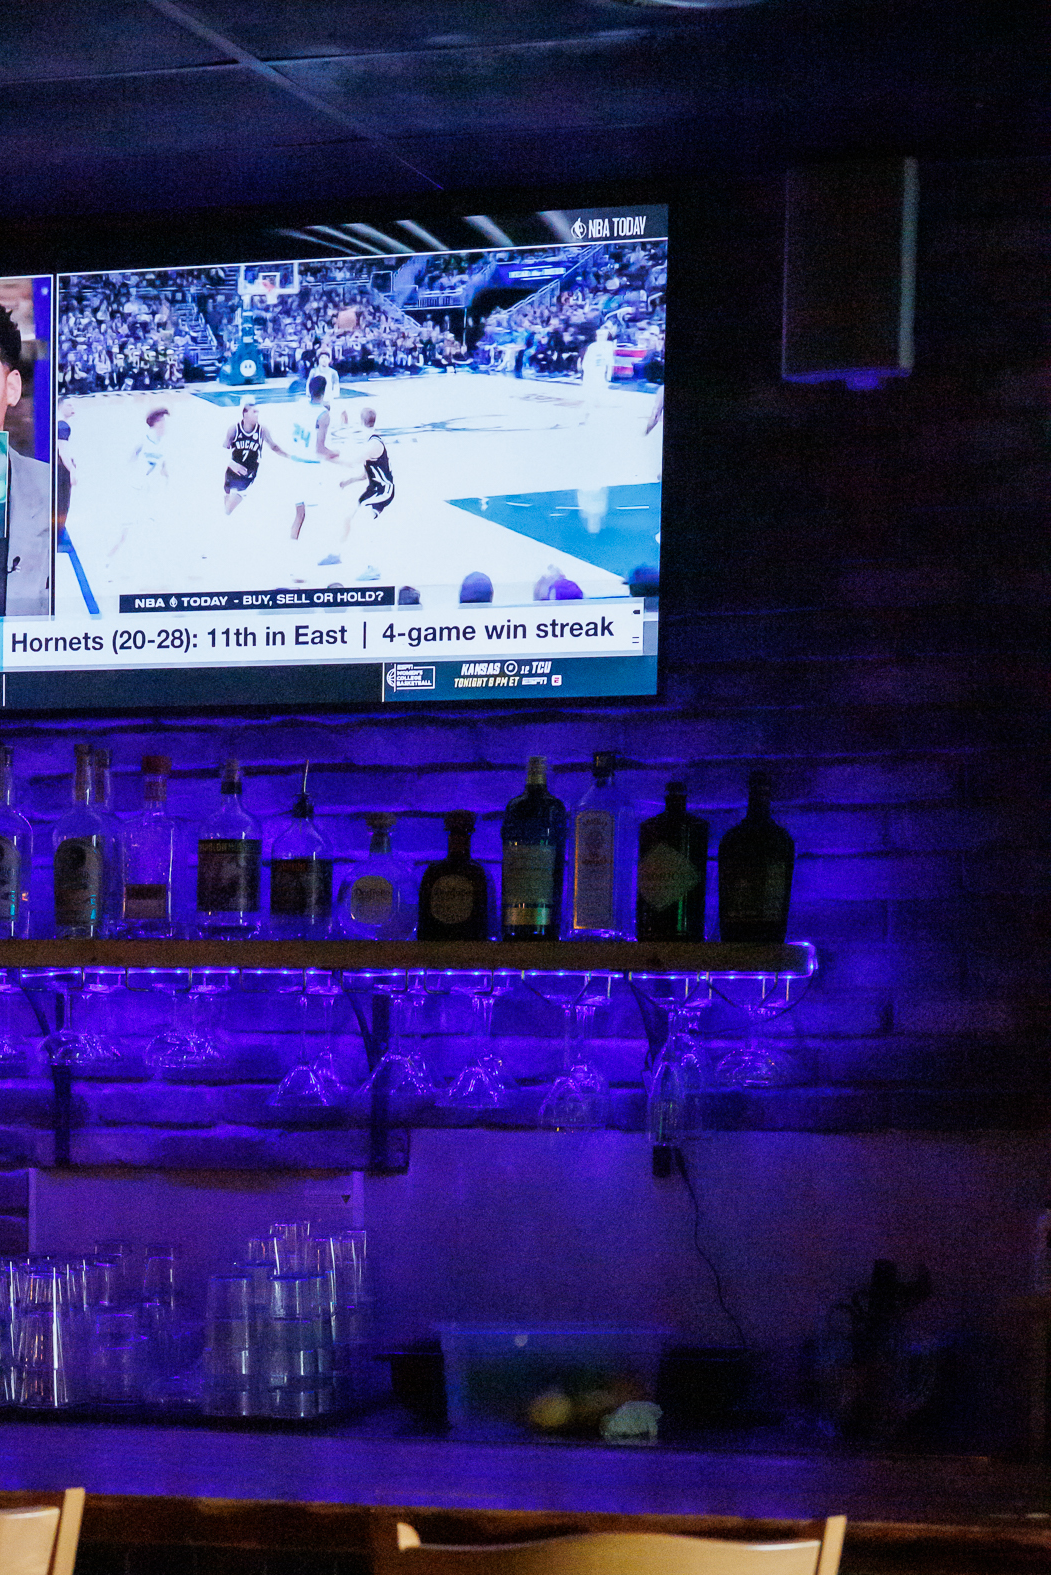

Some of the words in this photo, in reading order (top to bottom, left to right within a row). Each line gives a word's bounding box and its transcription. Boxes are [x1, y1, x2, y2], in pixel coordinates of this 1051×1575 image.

[588, 218, 610, 238] NBA
[612, 216, 647, 236] TODAY
[135, 597, 166, 609] NBA
[181, 596, 228, 608] TODAY
[242, 594, 272, 607] BUY,
[276, 593, 311, 605] SELL
[313, 592, 334, 604] OR
[337, 591, 384, 603] HOLD?
[11, 632, 104, 653] Hornets
[112, 628, 198, 654] (20-28):
[207, 627, 257, 648] 11th
[265, 626, 286, 647] in
[294, 625, 348, 646] East
[382, 622, 476, 648] 4-game
[485, 619, 527, 640] win
[535, 616, 615, 639] streak
[461, 662, 501, 676] KANSAS
[531, 661, 552, 674] TCU
[454, 677, 488, 688] TONIGHT
[495, 677, 508, 687] PM
[508, 676, 520, 687] ET
